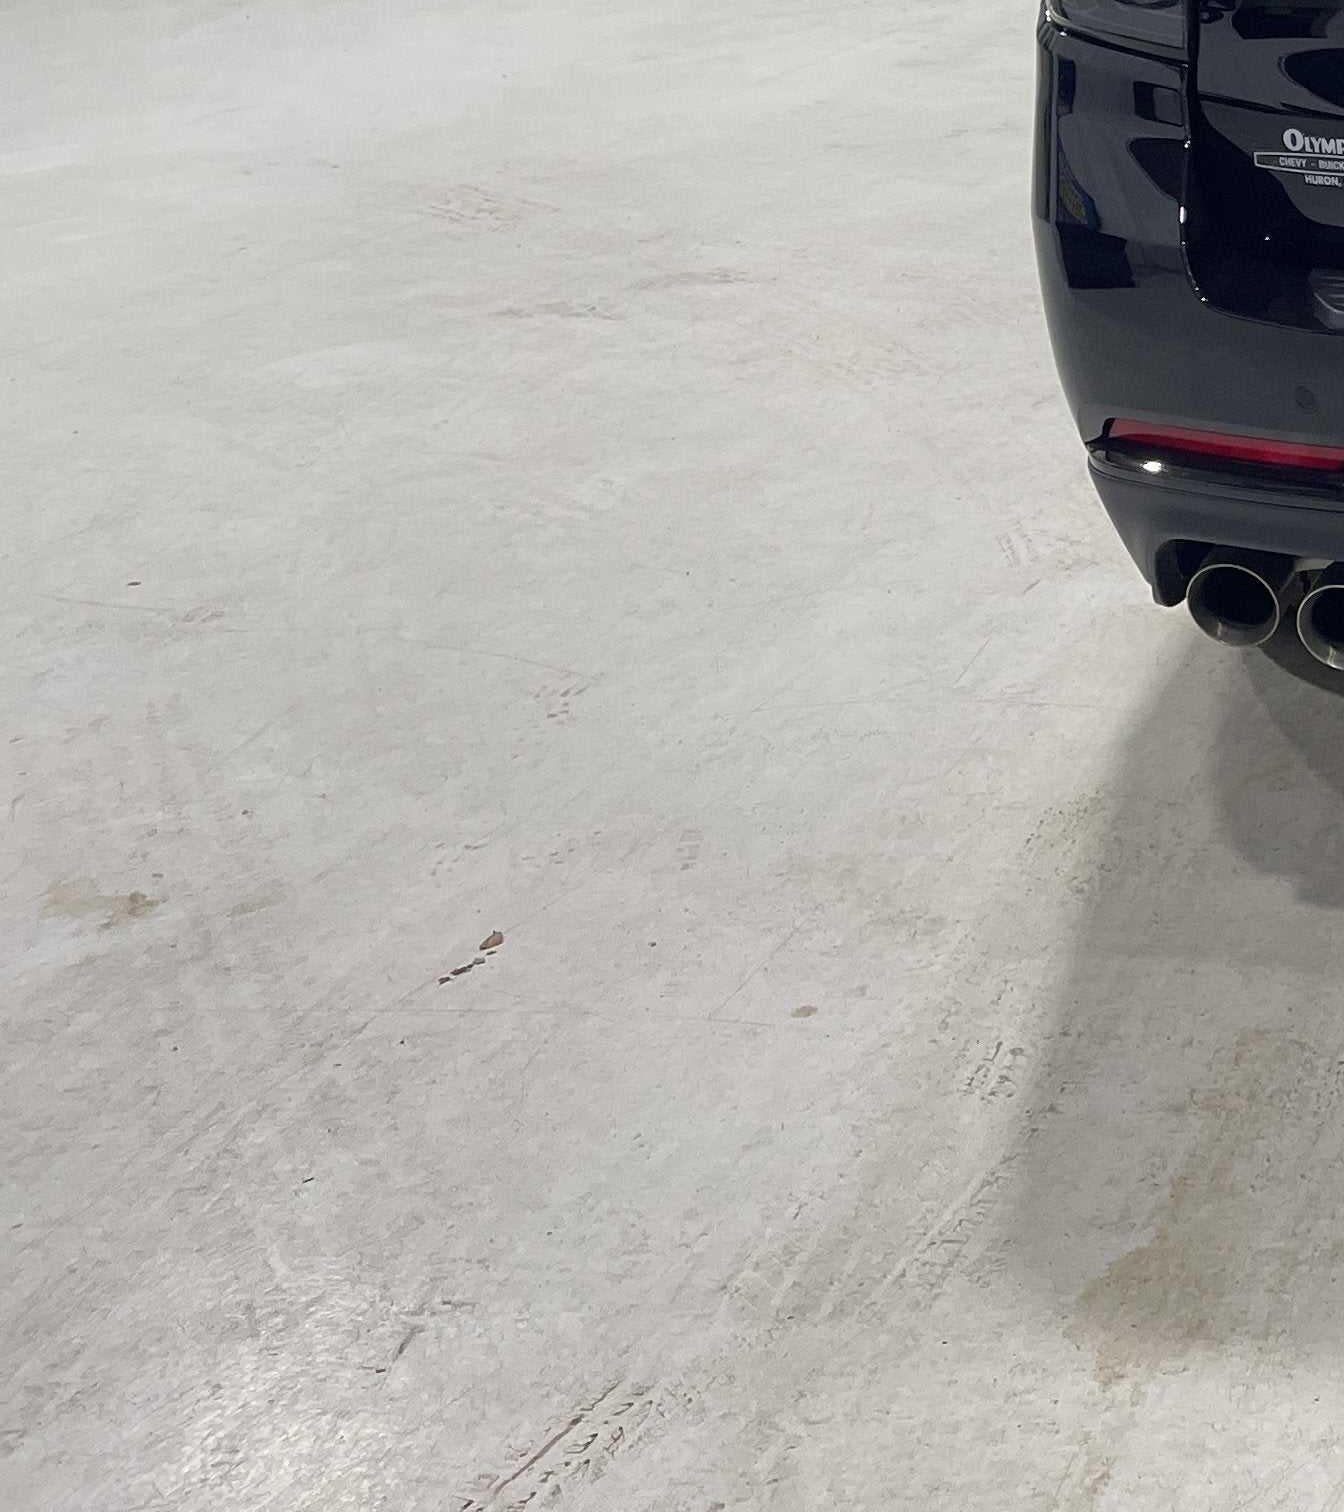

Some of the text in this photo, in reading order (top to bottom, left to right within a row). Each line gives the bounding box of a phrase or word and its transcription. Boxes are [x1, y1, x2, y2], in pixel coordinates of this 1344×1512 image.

[1279, 157, 1308, 168] CHEVY
[1318, 160, 1344, 172] BUICK
[1305, 174, 1342, 187] HURON,
